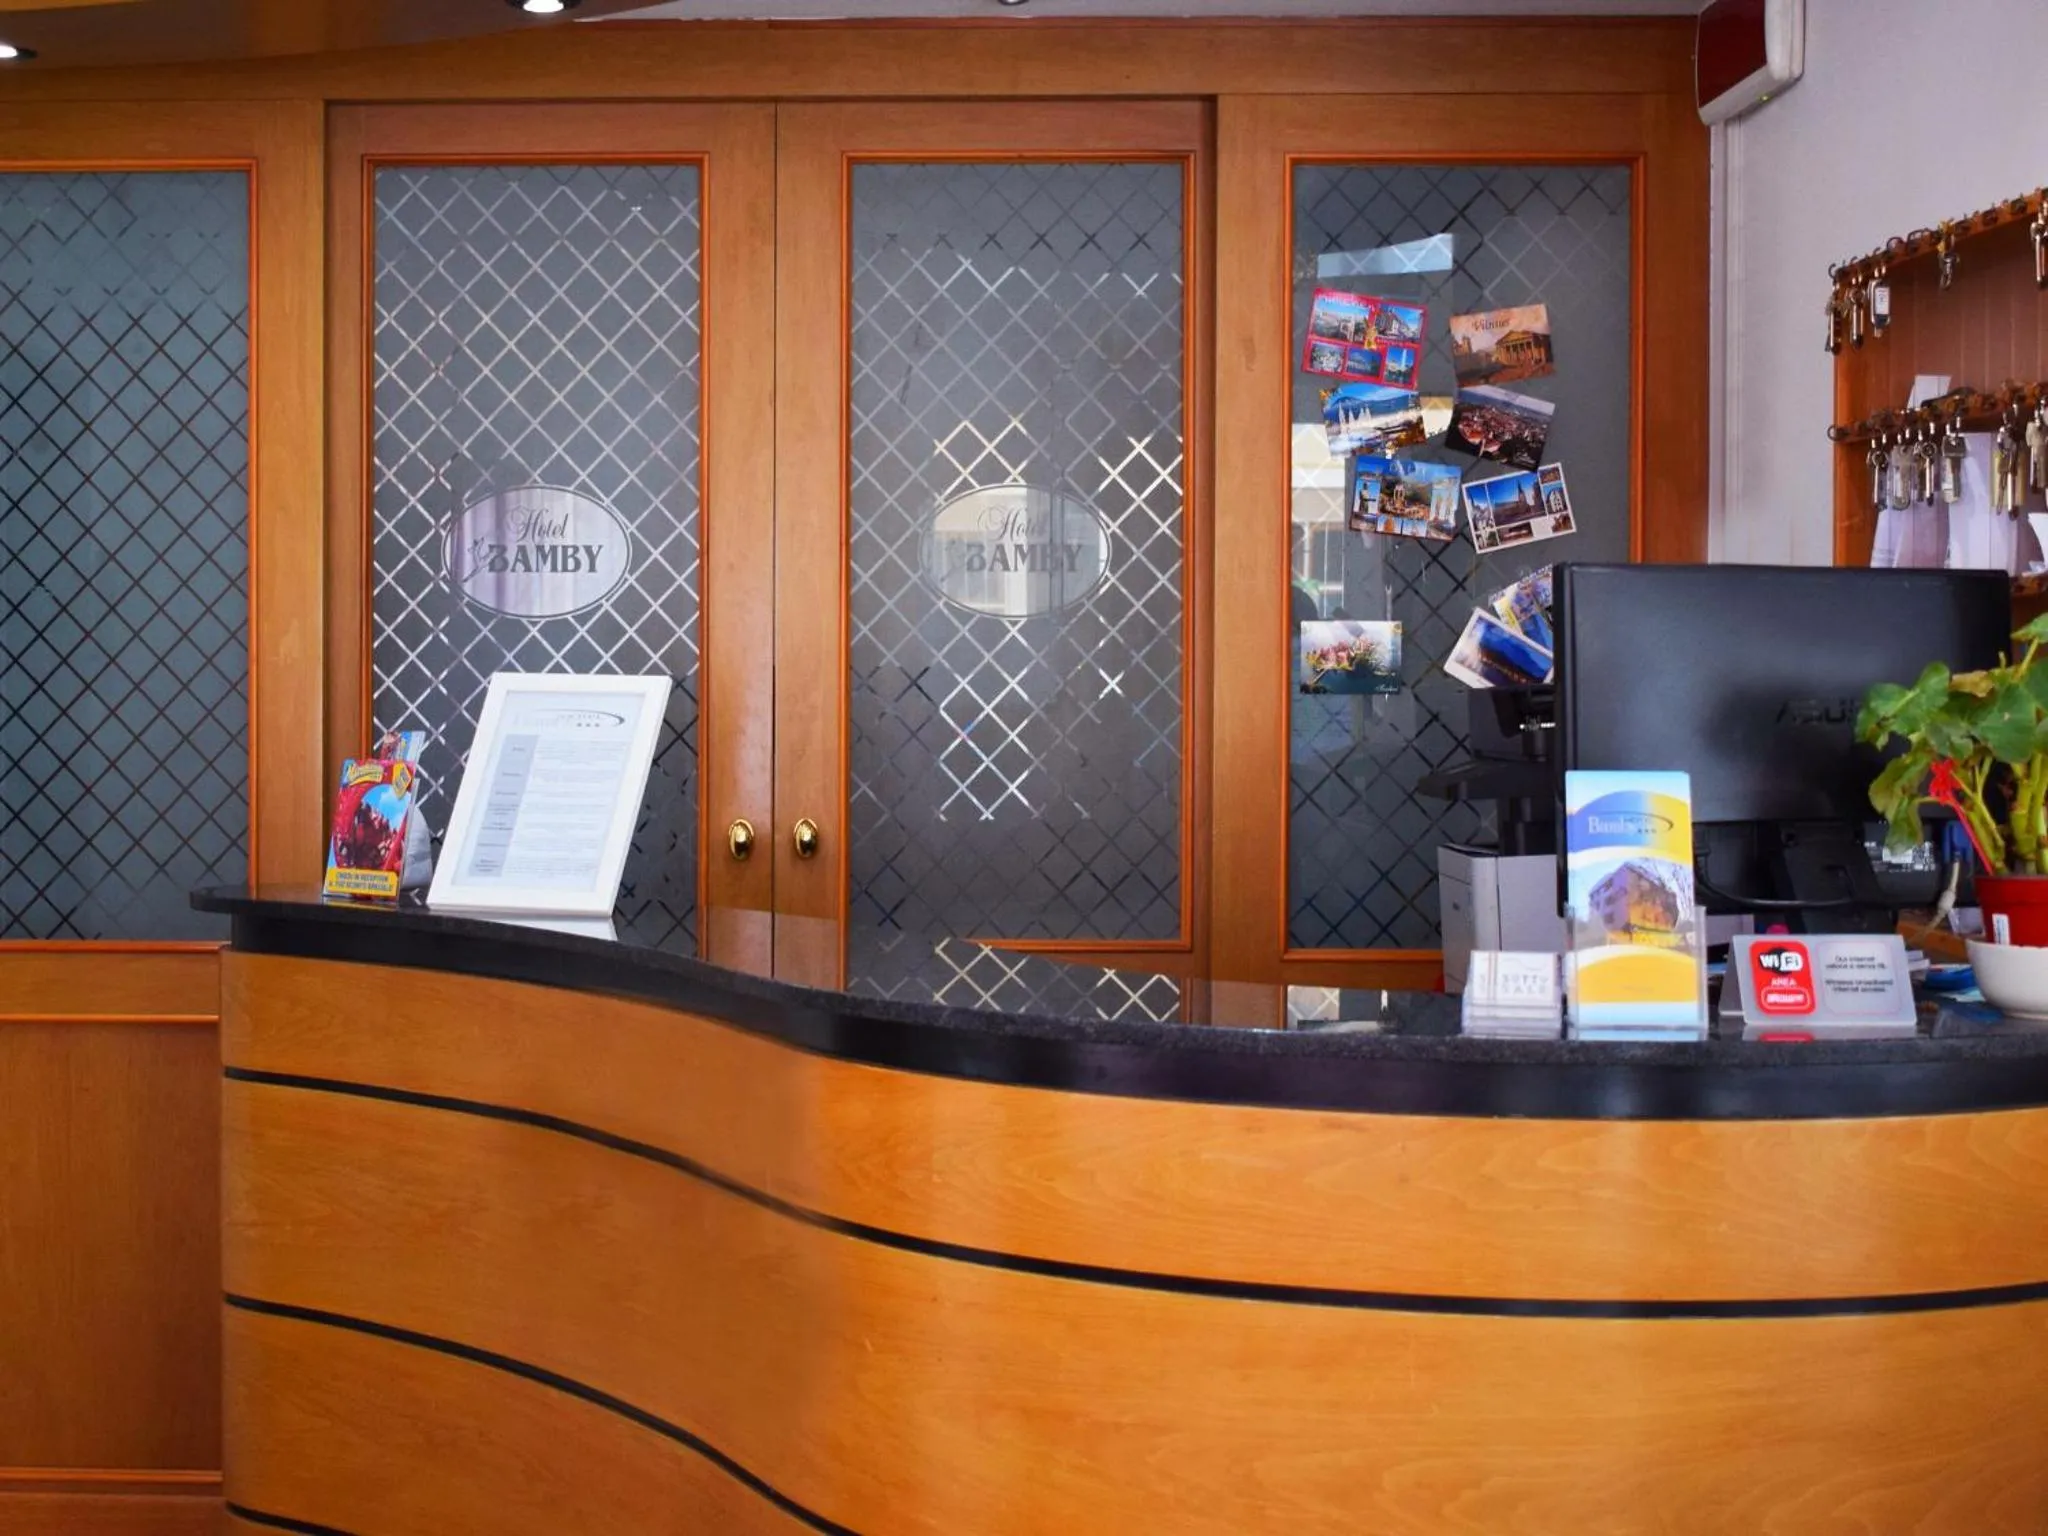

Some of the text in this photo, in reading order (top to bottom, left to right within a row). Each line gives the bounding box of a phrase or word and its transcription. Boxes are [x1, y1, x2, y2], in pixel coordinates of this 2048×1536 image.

[507, 505, 570, 543] Hotel
[487, 544, 604, 573] BAMBY
[966, 544, 1083, 572] BAMBY
